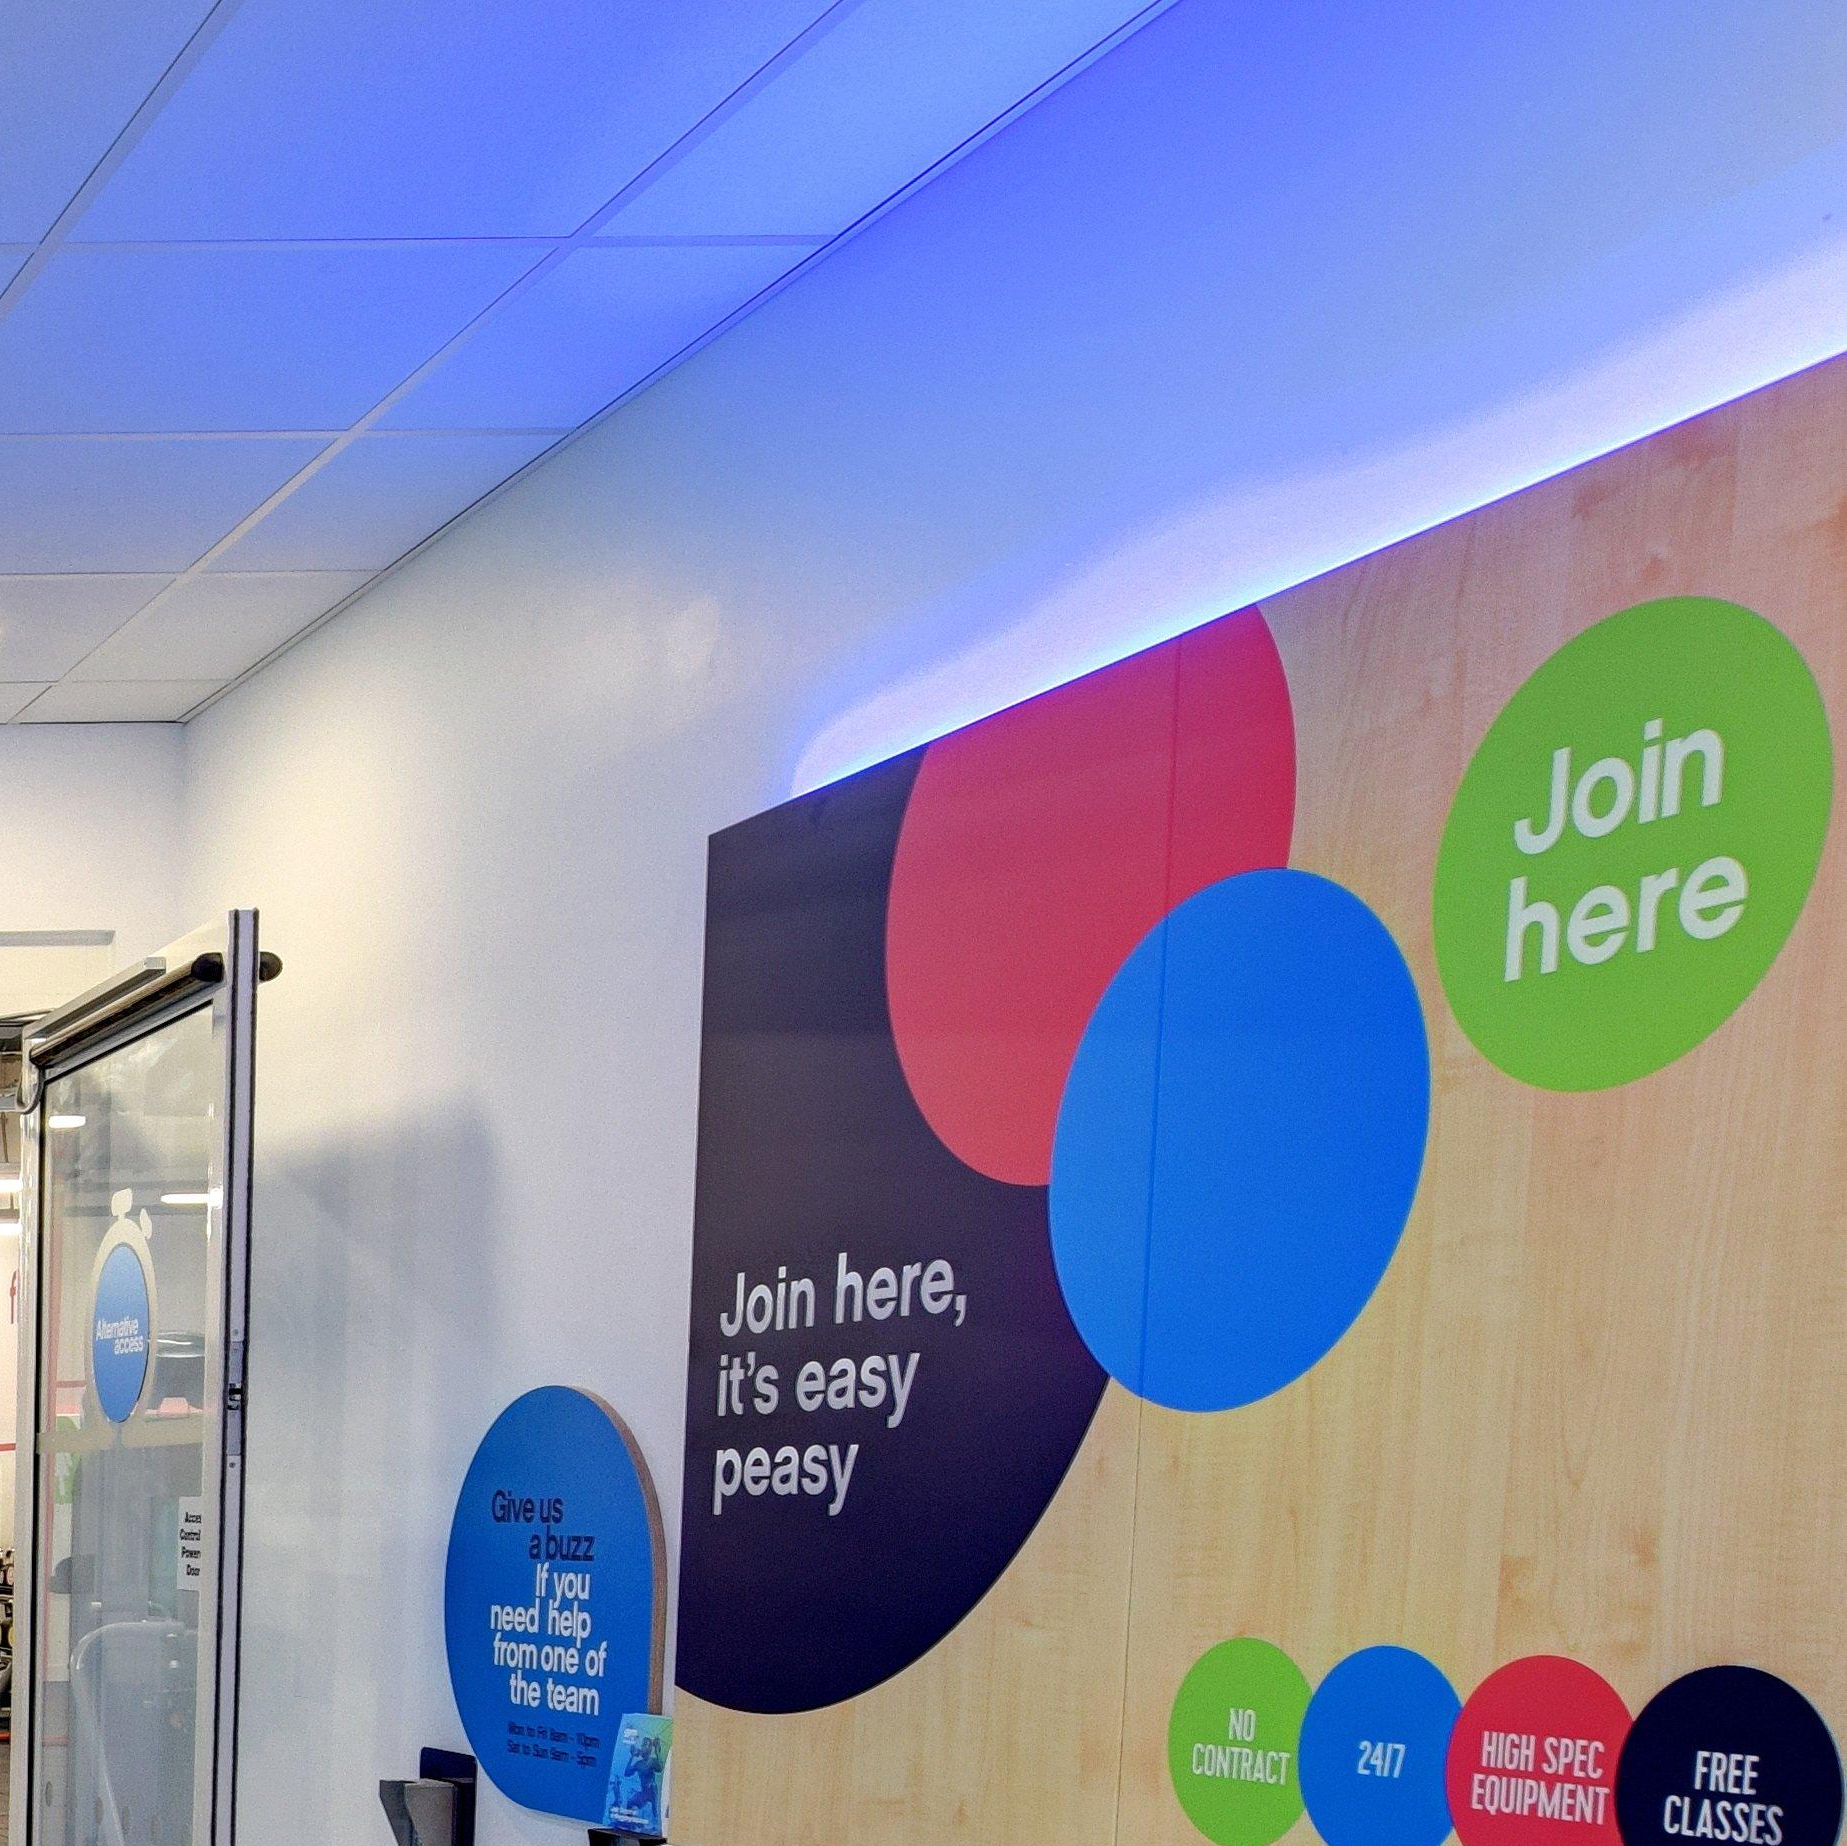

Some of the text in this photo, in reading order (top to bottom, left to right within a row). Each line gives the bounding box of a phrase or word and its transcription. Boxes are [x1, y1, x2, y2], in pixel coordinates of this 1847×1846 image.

[1514, 719, 1723, 854] Join
[1504, 856, 1747, 982] here
[720, 1252, 967, 1337] Join here,
[718, 1352, 921, 1428] it's easy
[713, 1445, 859, 1516] peasy
[491, 1490, 563, 1523] Give us
[529, 1524, 595, 1561] a buzz
[536, 1562, 591, 1609] If you
[490, 1598, 591, 1649] need help
[493, 1632, 608, 1677] from one of
[509, 1669, 600, 1716] the team
[1229, 1708, 1256, 1741] NO
[1192, 1743, 1290, 1786] CONTRACT
[1357, 1740, 1405, 1778] 24/7
[1481, 1731, 1605, 1779] HIGH SPEC
[1694, 1750, 1760, 1795] FREE
[1471, 1772, 1610, 1825] EQUIPMENT
[1663, 1795, 1784, 1846] CLASSES
